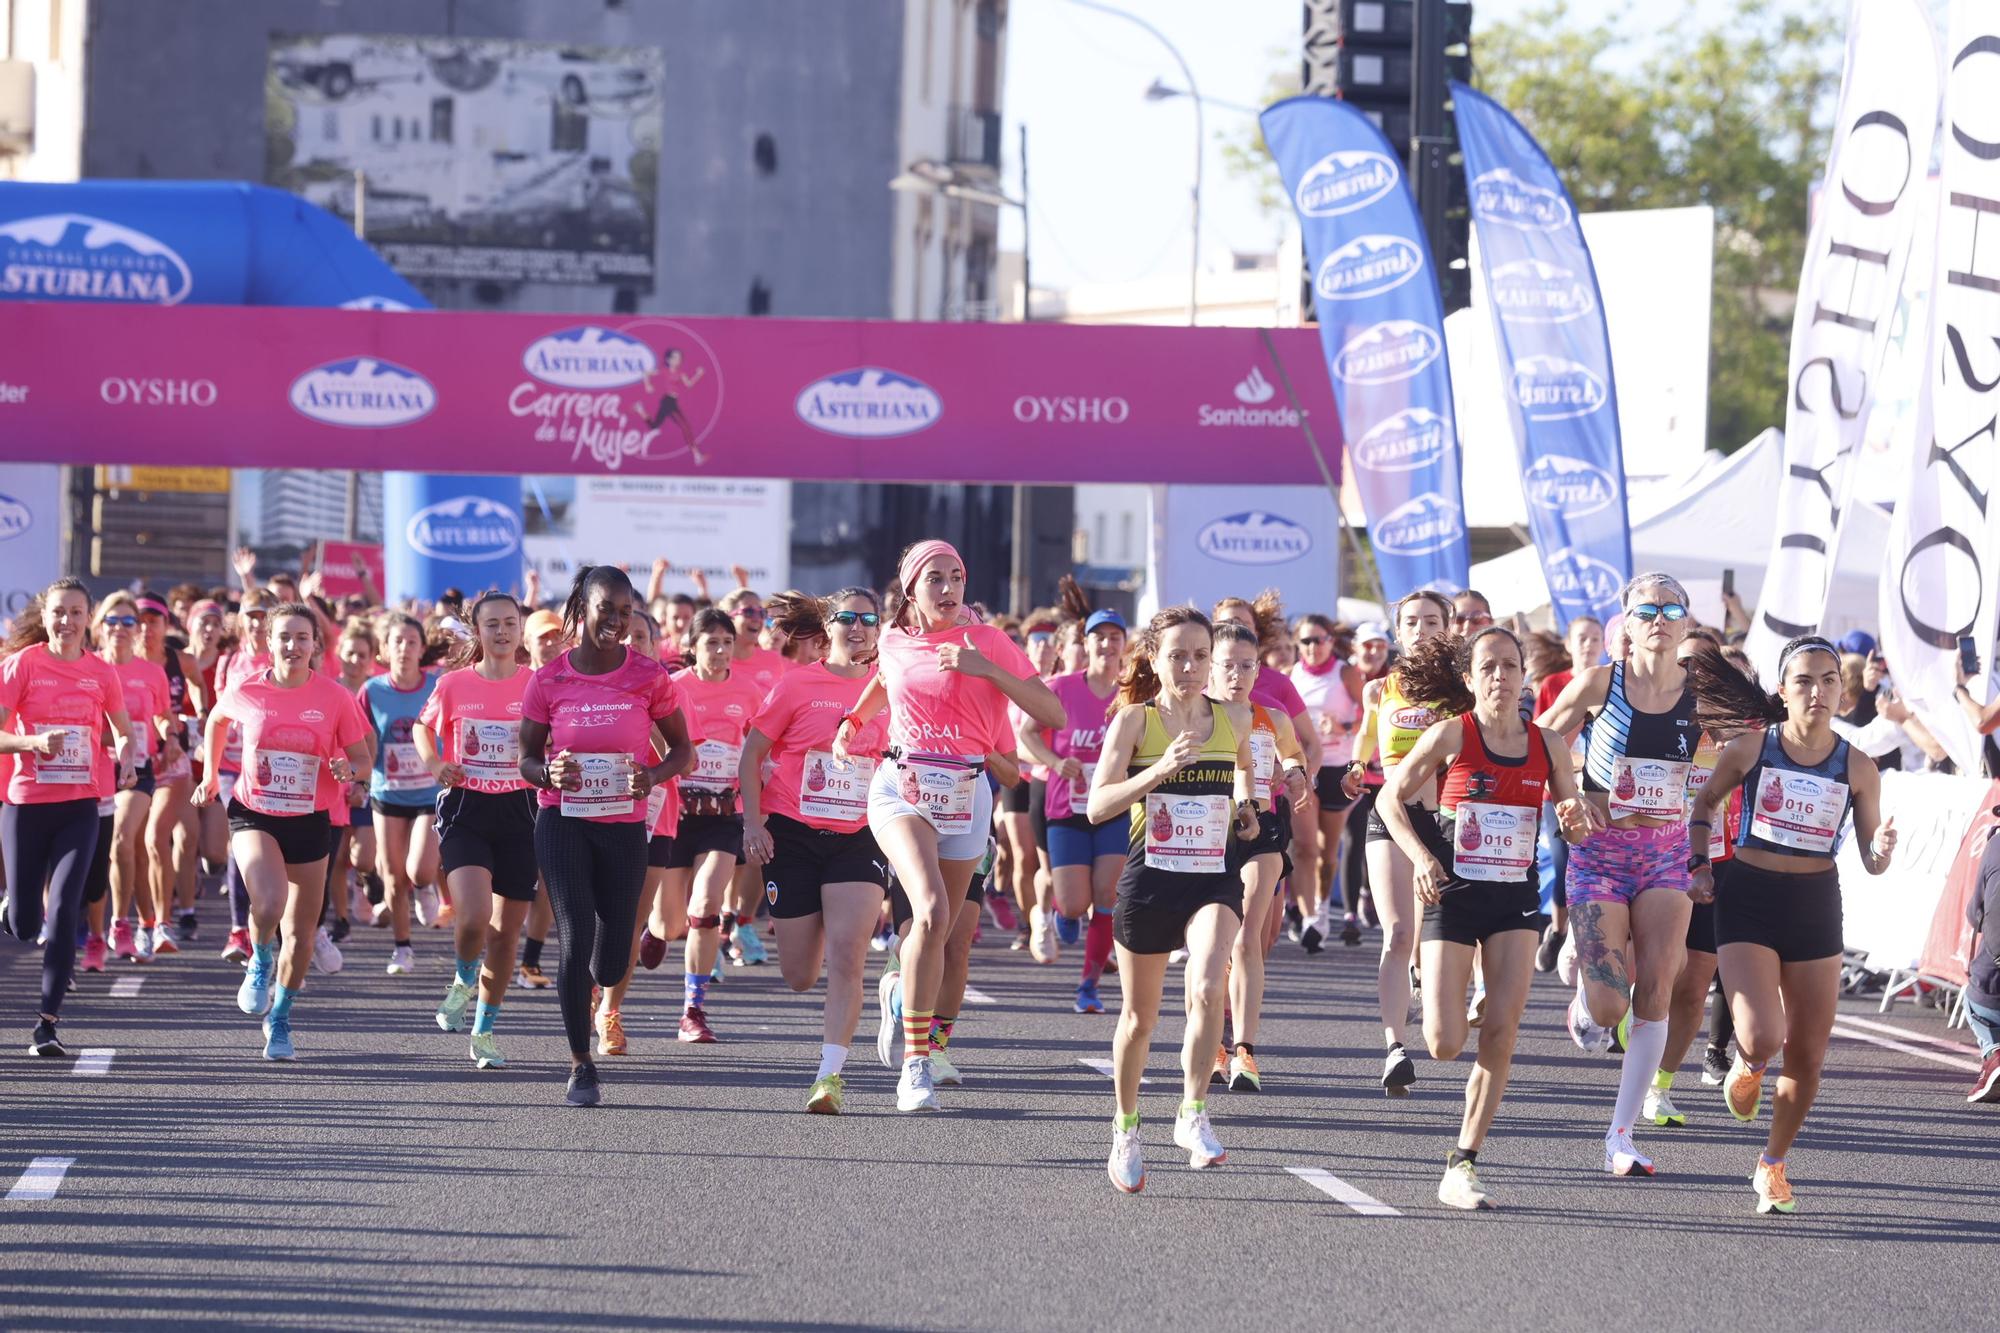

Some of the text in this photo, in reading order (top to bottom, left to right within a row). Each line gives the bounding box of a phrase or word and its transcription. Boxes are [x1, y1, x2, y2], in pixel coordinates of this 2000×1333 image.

[0, 263, 171, 299] STURIANA
[533, 350, 644, 374] ASTURIANA
[101, 377, 217, 406] OYSHO
[303, 383, 423, 410] ASTURIANA
[509, 382, 620, 417] Carrera
[809, 394, 930, 420] ASTURIANA
[1013, 396, 1130, 424] OYSHO
[535, 414, 662, 470] de la Mujer
[1208, 531, 1303, 552] ASTURIANA
[457, 703, 484, 711] OYSHO
[592, 703, 633, 712] Santander
[811, 700, 842, 709] OYSHO
[481, 743, 504, 753] 016
[701, 760, 723, 770] 016
[273, 774, 296, 785] 016
[584, 778, 609, 788] 016
[827, 778, 851, 790] 016
[922, 776, 952, 787] ASTURIANA
[922, 792, 949, 804] 016
[1637, 786, 1664, 798] 016
[806, 805, 829, 814] OYSHO
[1175, 806, 1206, 815] ASTURIANA
[1785, 799, 1814, 814] 016
[1483, 817, 1515, 826] ASTURIANA
[1790, 813, 1804, 822] 313
[1175, 825, 1204, 837] 016
[1605, 820, 1684, 841] RO NIK
[1185, 838, 1194, 846] 11
[1484, 834, 1513, 847] 016
[1493, 848, 1502, 856] 10
[1461, 867, 1487, 875] OYSHO
